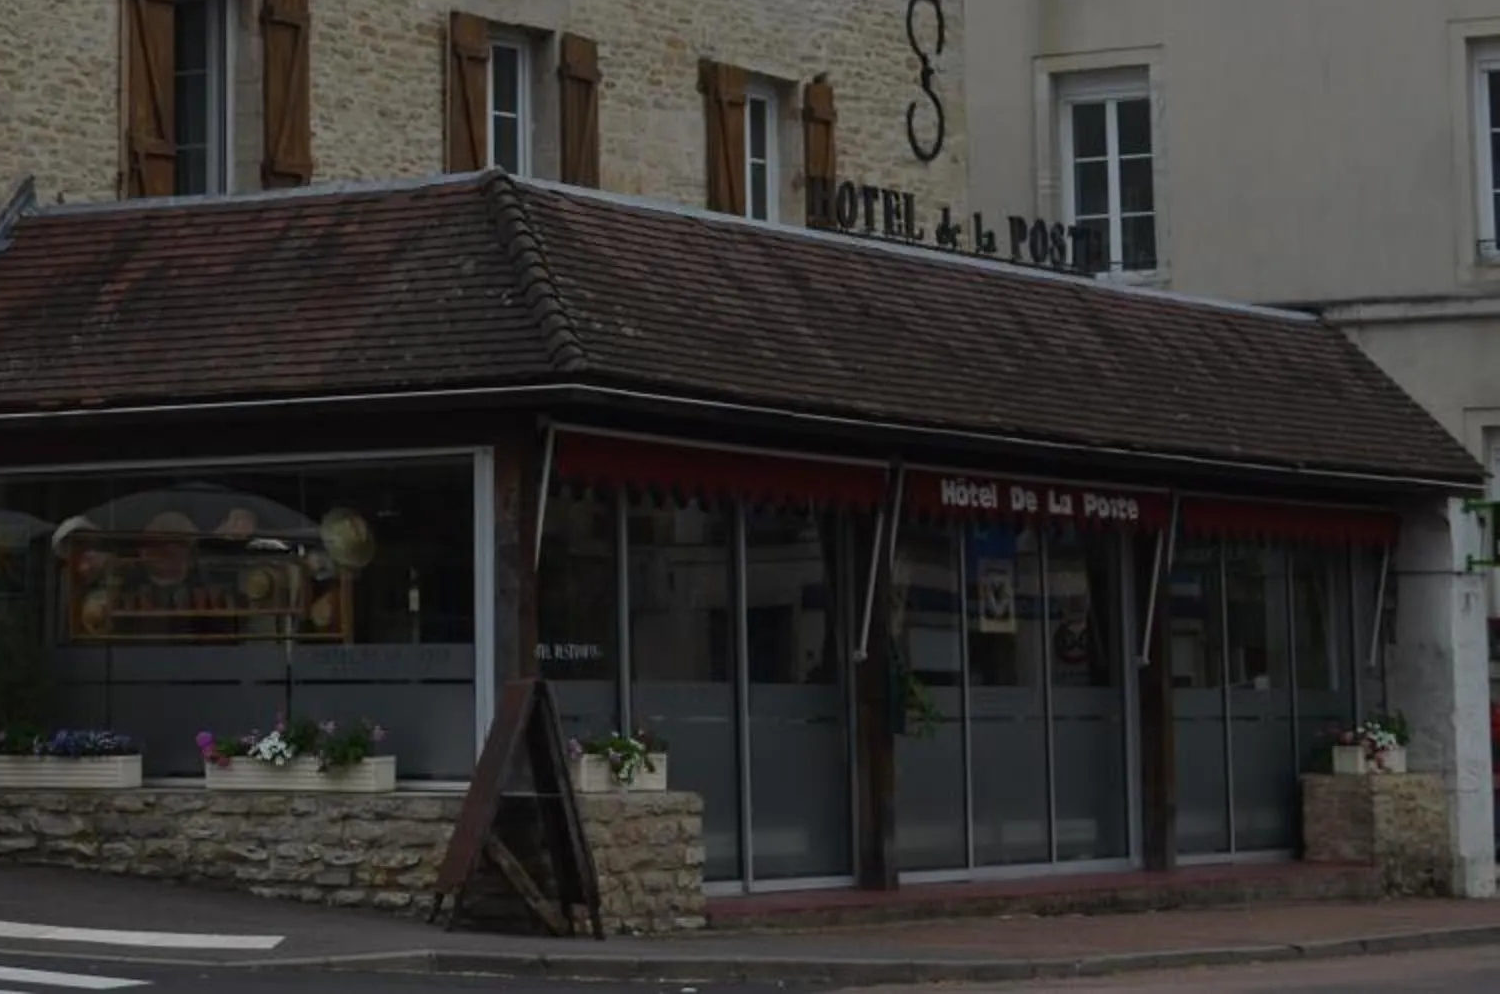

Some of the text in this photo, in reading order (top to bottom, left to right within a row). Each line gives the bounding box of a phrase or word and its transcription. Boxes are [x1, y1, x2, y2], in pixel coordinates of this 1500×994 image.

[806, 176, 924, 240] HOTEL
[973, 212, 997, 253] la
[1010, 486, 1038, 512] De
[1048, 489, 1073, 515] La
